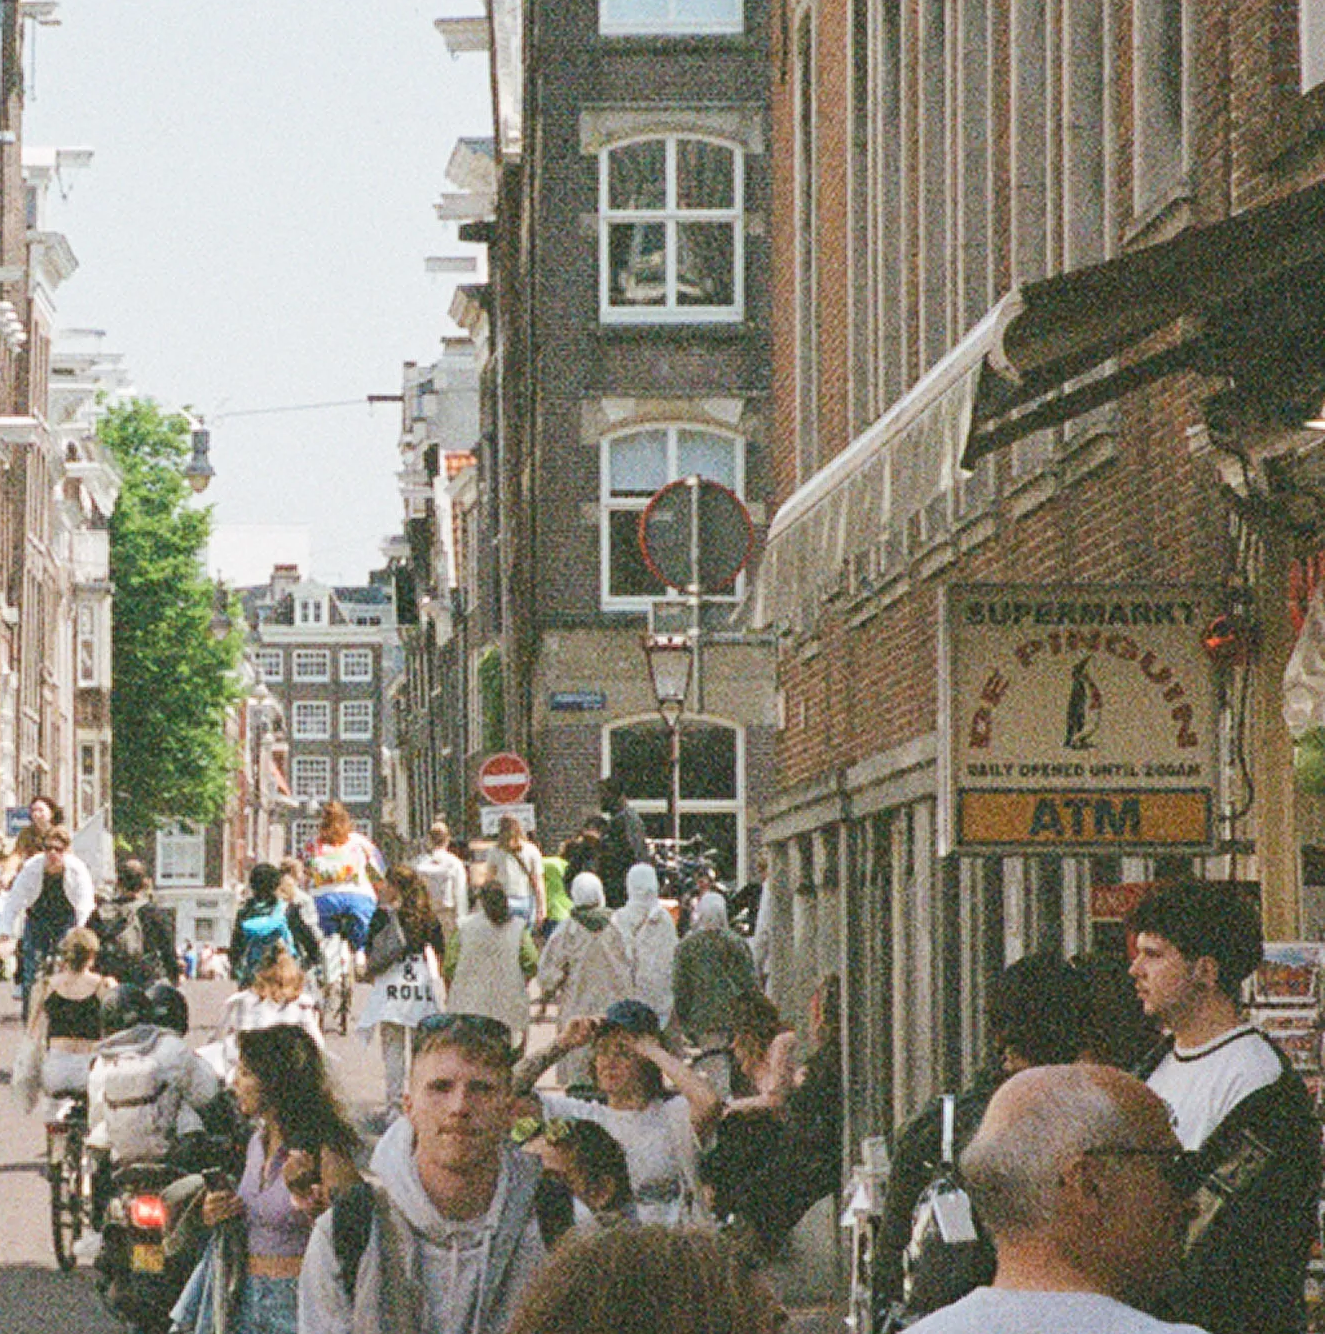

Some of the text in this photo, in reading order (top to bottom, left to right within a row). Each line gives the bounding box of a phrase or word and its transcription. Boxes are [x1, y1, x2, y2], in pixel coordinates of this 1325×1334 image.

[965, 601, 1199, 626] SUPERMARKT
[968, 629, 1199, 749] DE PINGUIN
[967, 763, 1014, 777] DAILY
[1018, 763, 1085, 778] OPENED
[1089, 763, 1139, 777] UNTIL
[1029, 797, 1141, 836] ATM
[386, 984, 433, 1002] ROLL
